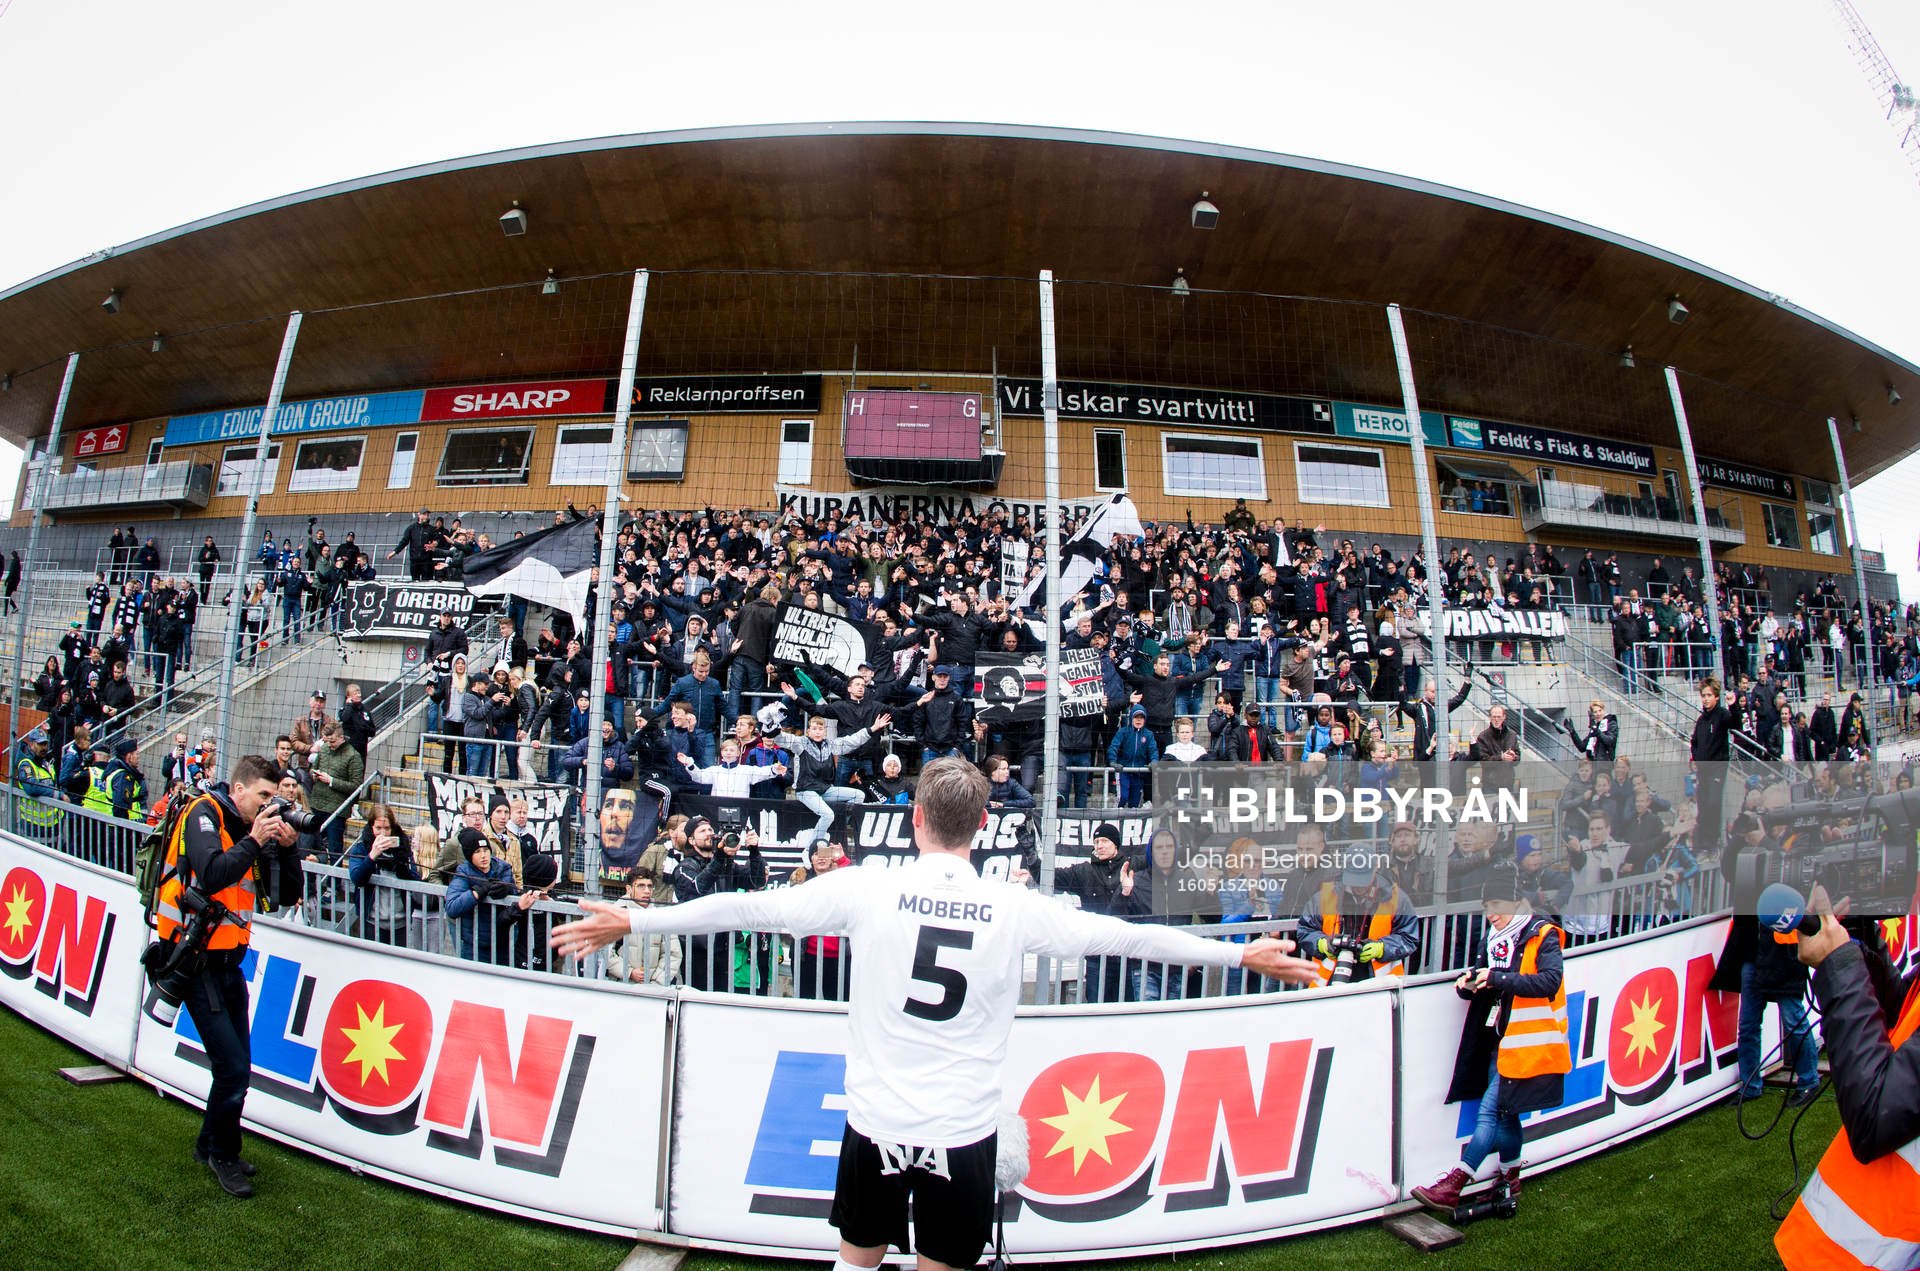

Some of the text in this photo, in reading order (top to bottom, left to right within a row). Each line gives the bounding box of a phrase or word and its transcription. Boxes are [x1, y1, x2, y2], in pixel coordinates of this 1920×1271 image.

[452, 389, 570, 413] SHARP
[650, 386, 805, 403] Reklamproffsen
[850, 398, 864, 416] H
[963, 399, 976, 418] G
[1004, 386, 1030, 409] Vi
[1137, 397, 1255, 423] svartvitt!
[220, 397, 369, 438] EDUCTION GROUP
[1547, 438, 1578, 456] Fisk
[1583, 444, 1593, 459] &
[1597, 446, 1650, 469] Skaldjur
[1712, 464, 1725, 481] ÄR
[1728, 469, 1774, 490] SVARTVITT
[395, 589, 474, 612] ÖREBRO
[392, 611, 424, 626] TIFO
[429, 614, 469, 629] 202
[784, 606, 837, 633] ULTRAS
[1067, 648, 1098, 663] HELL
[1066, 661, 1101, 681] CAN'T
[859, 811, 1026, 850] ULAS
[898, 893, 992, 923] MOBERG
[903, 924, 974, 1022] 5
[1456, 953, 1740, 1138] LON
[744, 1038, 1314, 1196] EON
[871, 1138, 952, 1182] NA
